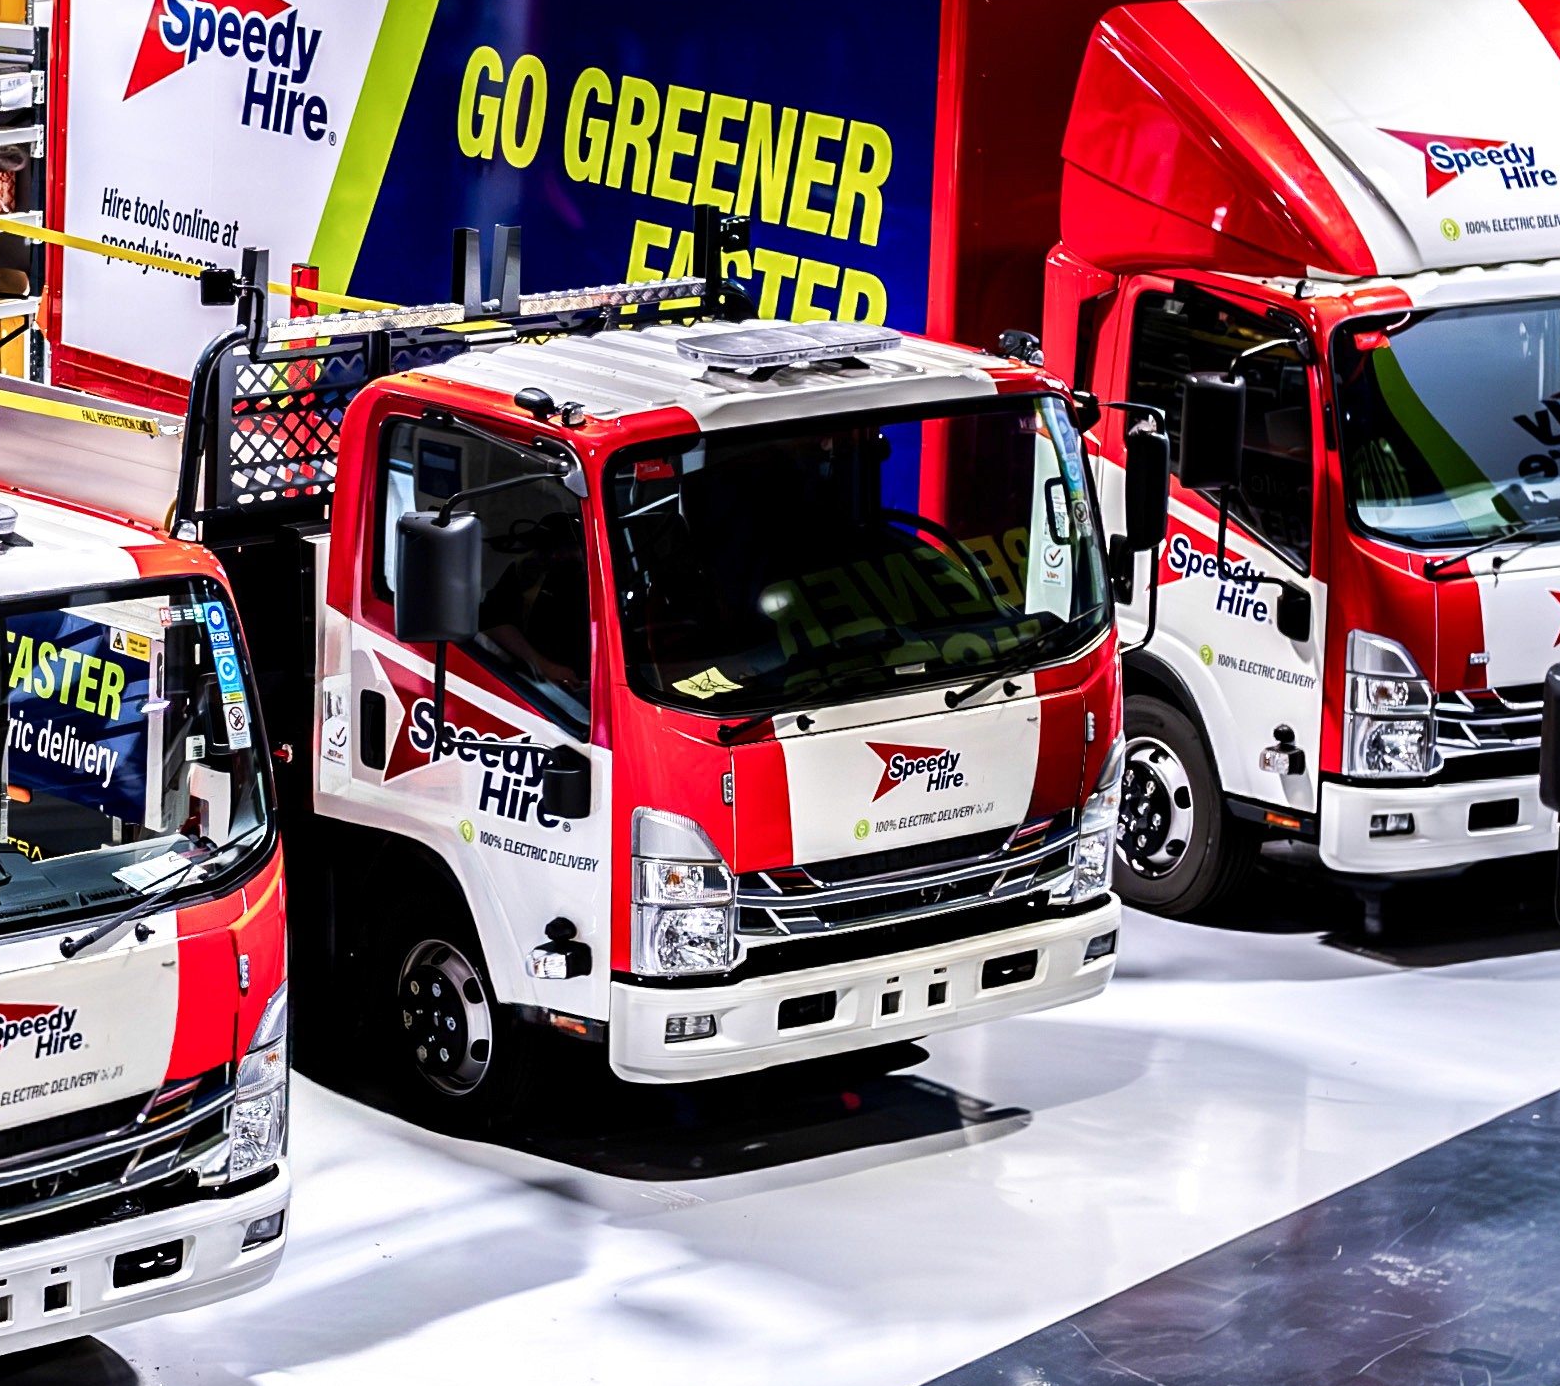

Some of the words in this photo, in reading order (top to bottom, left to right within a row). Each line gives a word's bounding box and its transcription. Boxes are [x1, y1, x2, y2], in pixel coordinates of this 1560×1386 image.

[241, 67, 328, 143] Hire
[457, 45, 547, 169] GO
[564, 66, 893, 247] GREENER
[1431, 142, 1535, 173] Speedy
[1502, 164, 1557, 190] Hire
[101, 186, 132, 219] Hire
[134, 195, 170, 232] tools
[173, 205, 219, 244] online
[221, 220, 240, 248] at
[1465, 219, 1491, 235] 100%
[1492, 215, 1536, 233] ELECTRIC
[620, 218, 888, 326] FATER
[82, 409, 97, 424] FALL
[97, 412, 136, 431] PROTECTION
[1168, 537, 1264, 595] Speedy
[1216, 580, 1268, 625] Hire
[210, 632, 230, 643] FORS
[1216, 653, 1237, 670] 100%
[1238, 658, 1274, 684] ELECTRIC
[1274, 667, 1317, 690] DELIVERY
[37, 719, 118, 788] delivery
[411, 701, 553, 788] Speedy
[890, 750, 960, 782] Speedy
[926, 772, 964, 792] Hire
[875, 819, 898, 833] 100%
[898, 812, 937, 830] ELECTRIC
[937, 804, 975, 822] DELIVERY
[479, 830, 502, 848] 100%
[503, 838, 548, 864] ELECTRIC
[548, 849, 599, 873] DELIVERY
[35, 1028, 82, 1060] Hire
[0, 1083, 49, 1109] ELECTRIC
[49, 1069, 99, 1099] DELIVERY
